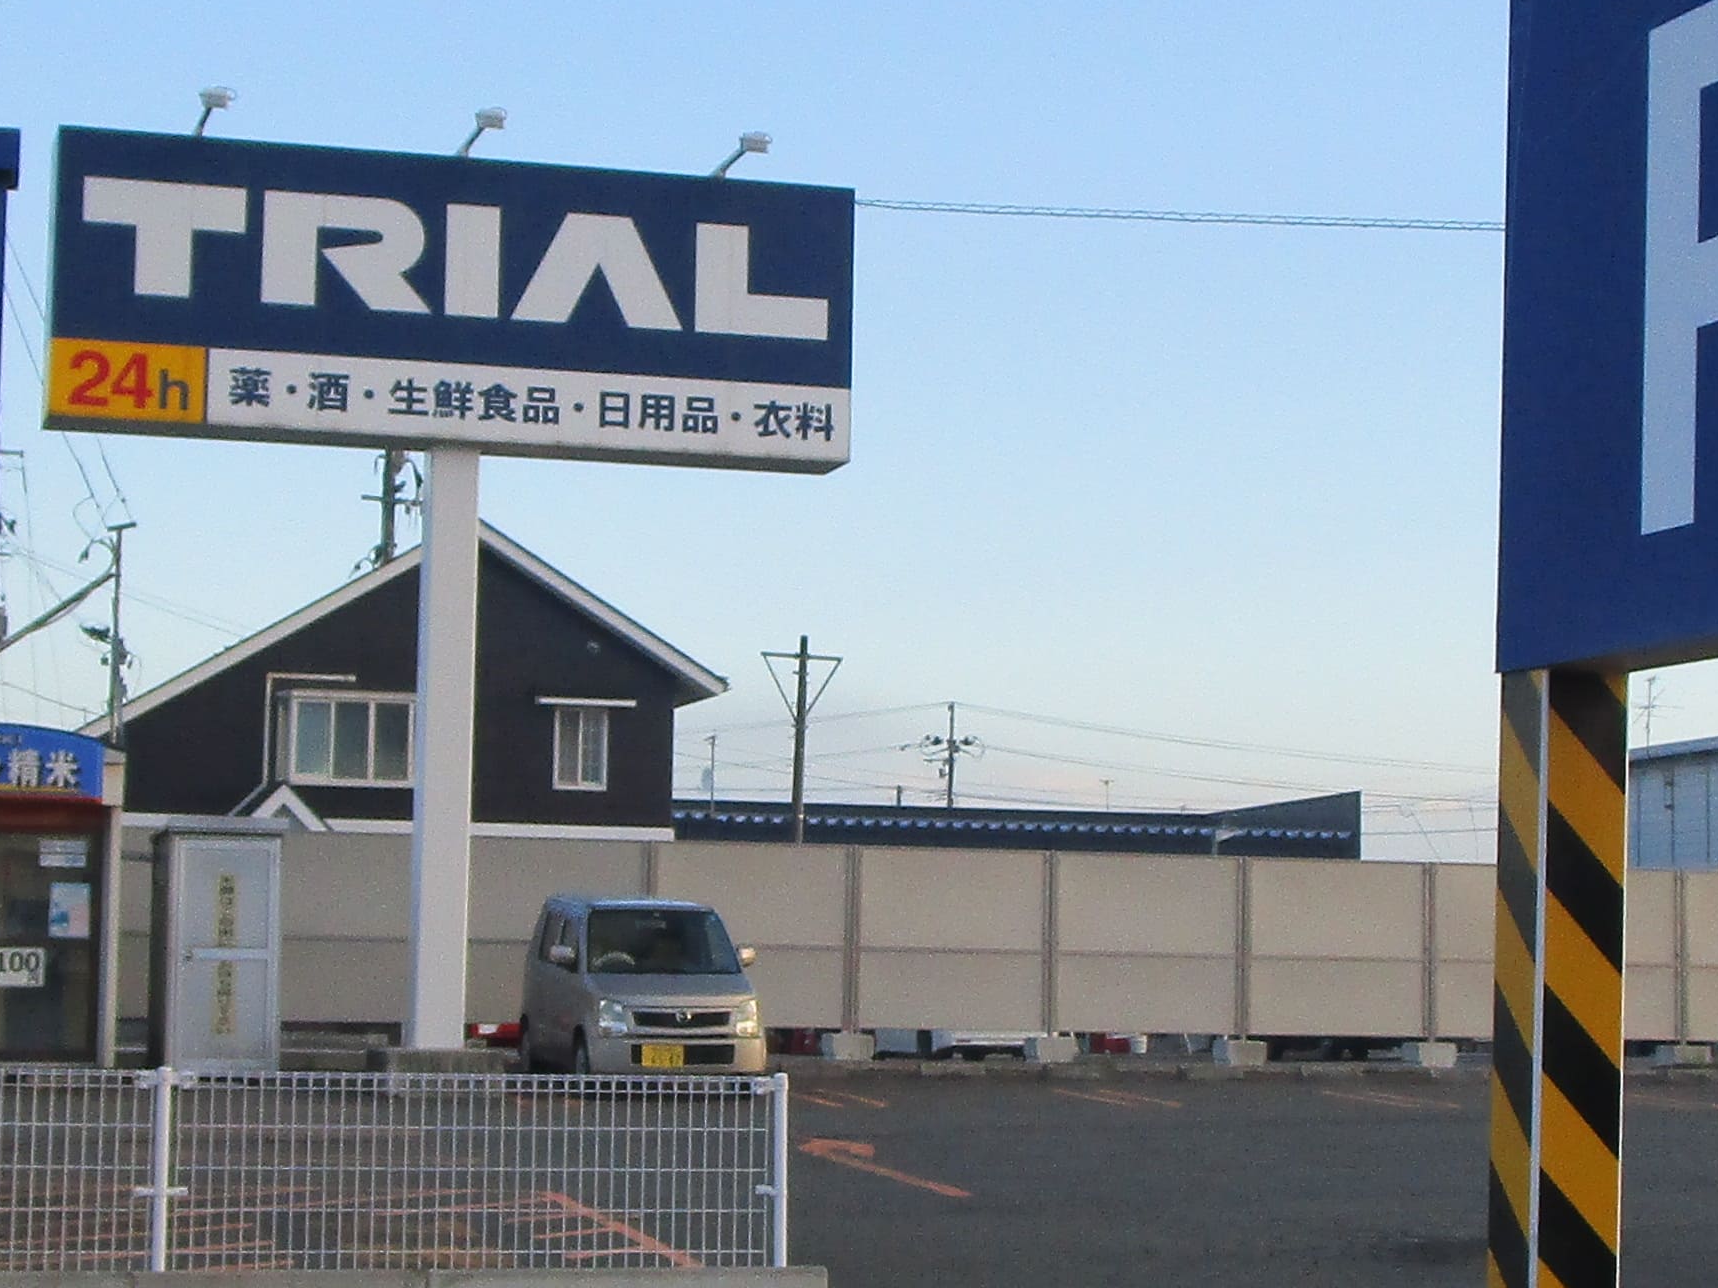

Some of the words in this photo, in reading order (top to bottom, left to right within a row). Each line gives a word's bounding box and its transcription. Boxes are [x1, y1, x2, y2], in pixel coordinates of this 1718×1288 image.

[82, 175, 829, 341] TRIAL
[68, 350, 190, 411] 24h
[228, 366, 836, 443] 薬・酒・生鮮食品・日用品・衣料
